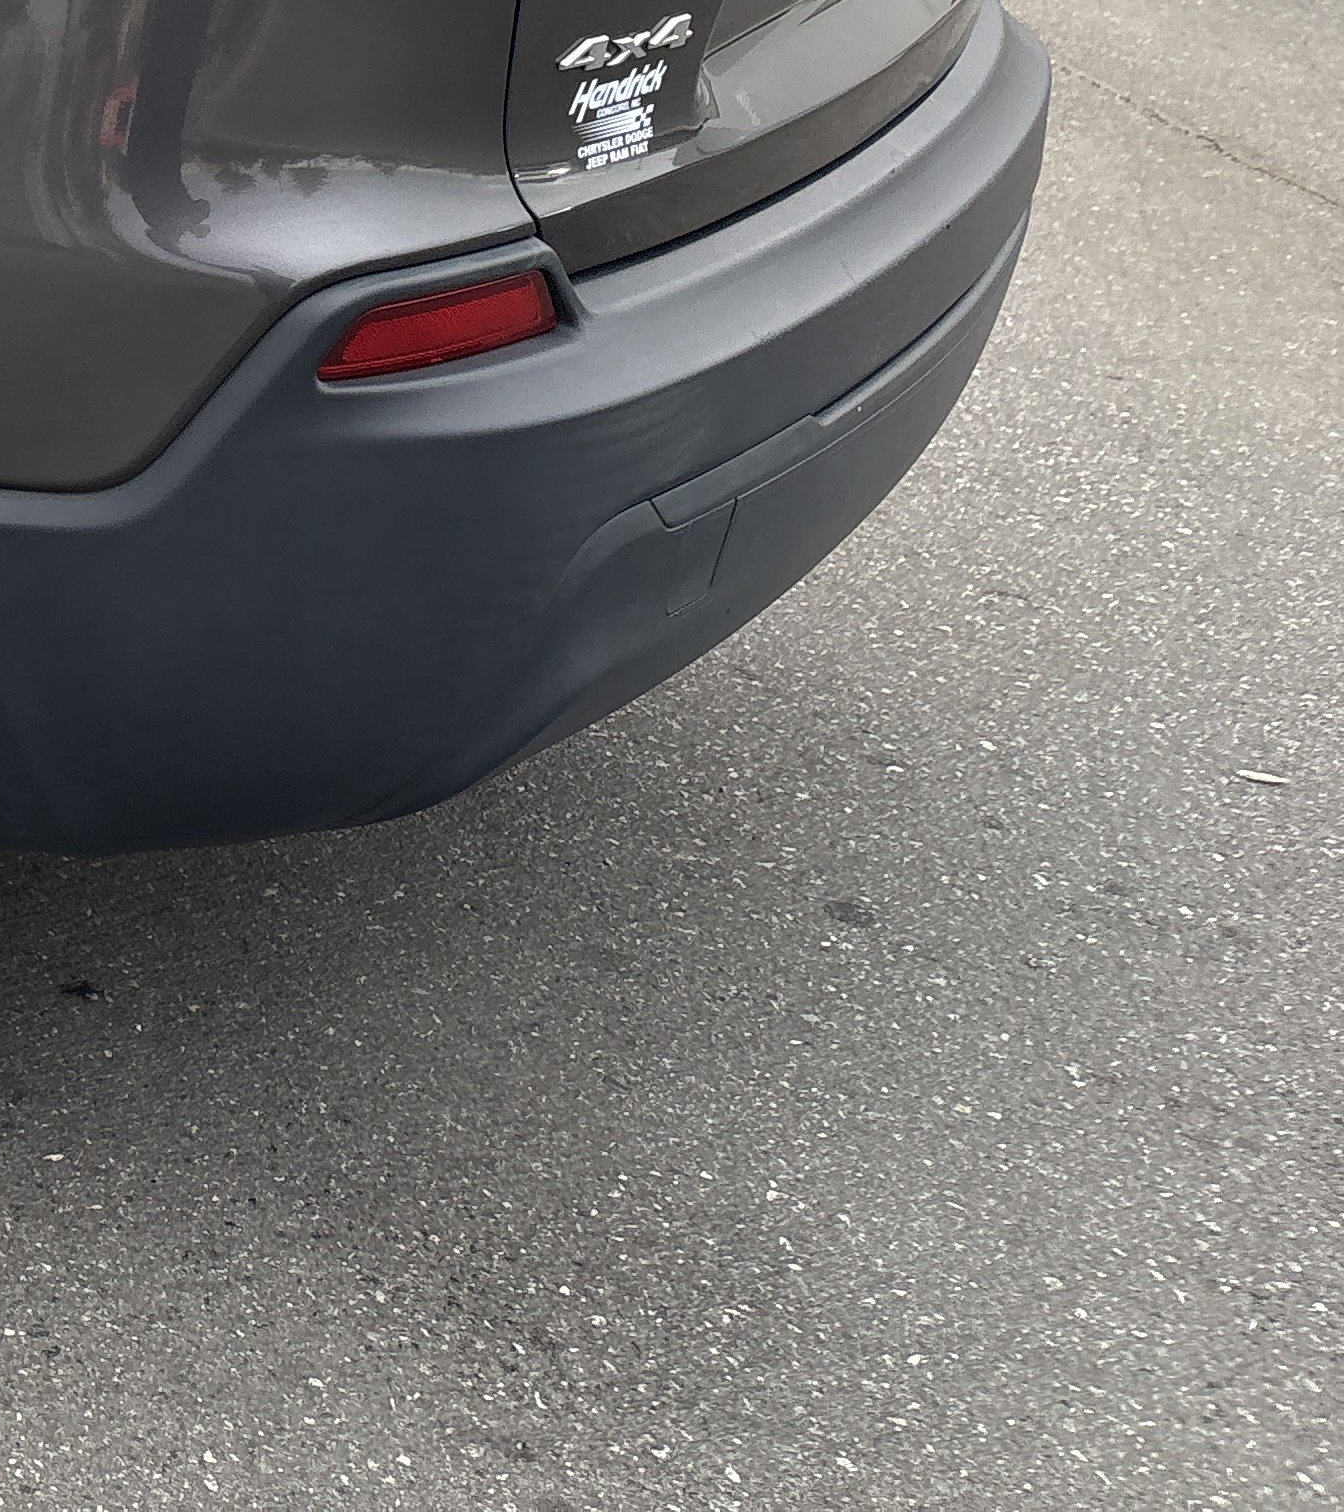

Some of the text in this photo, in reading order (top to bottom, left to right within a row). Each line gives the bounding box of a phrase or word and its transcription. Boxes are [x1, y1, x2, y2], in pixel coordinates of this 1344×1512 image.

[555, 12, 693, 71] 4x4
[568, 59, 668, 123] Hendrick
[577, 125, 654, 159] CHRYSLER DODGE
[586, 140, 649, 171] JEEP RAM FIAT
